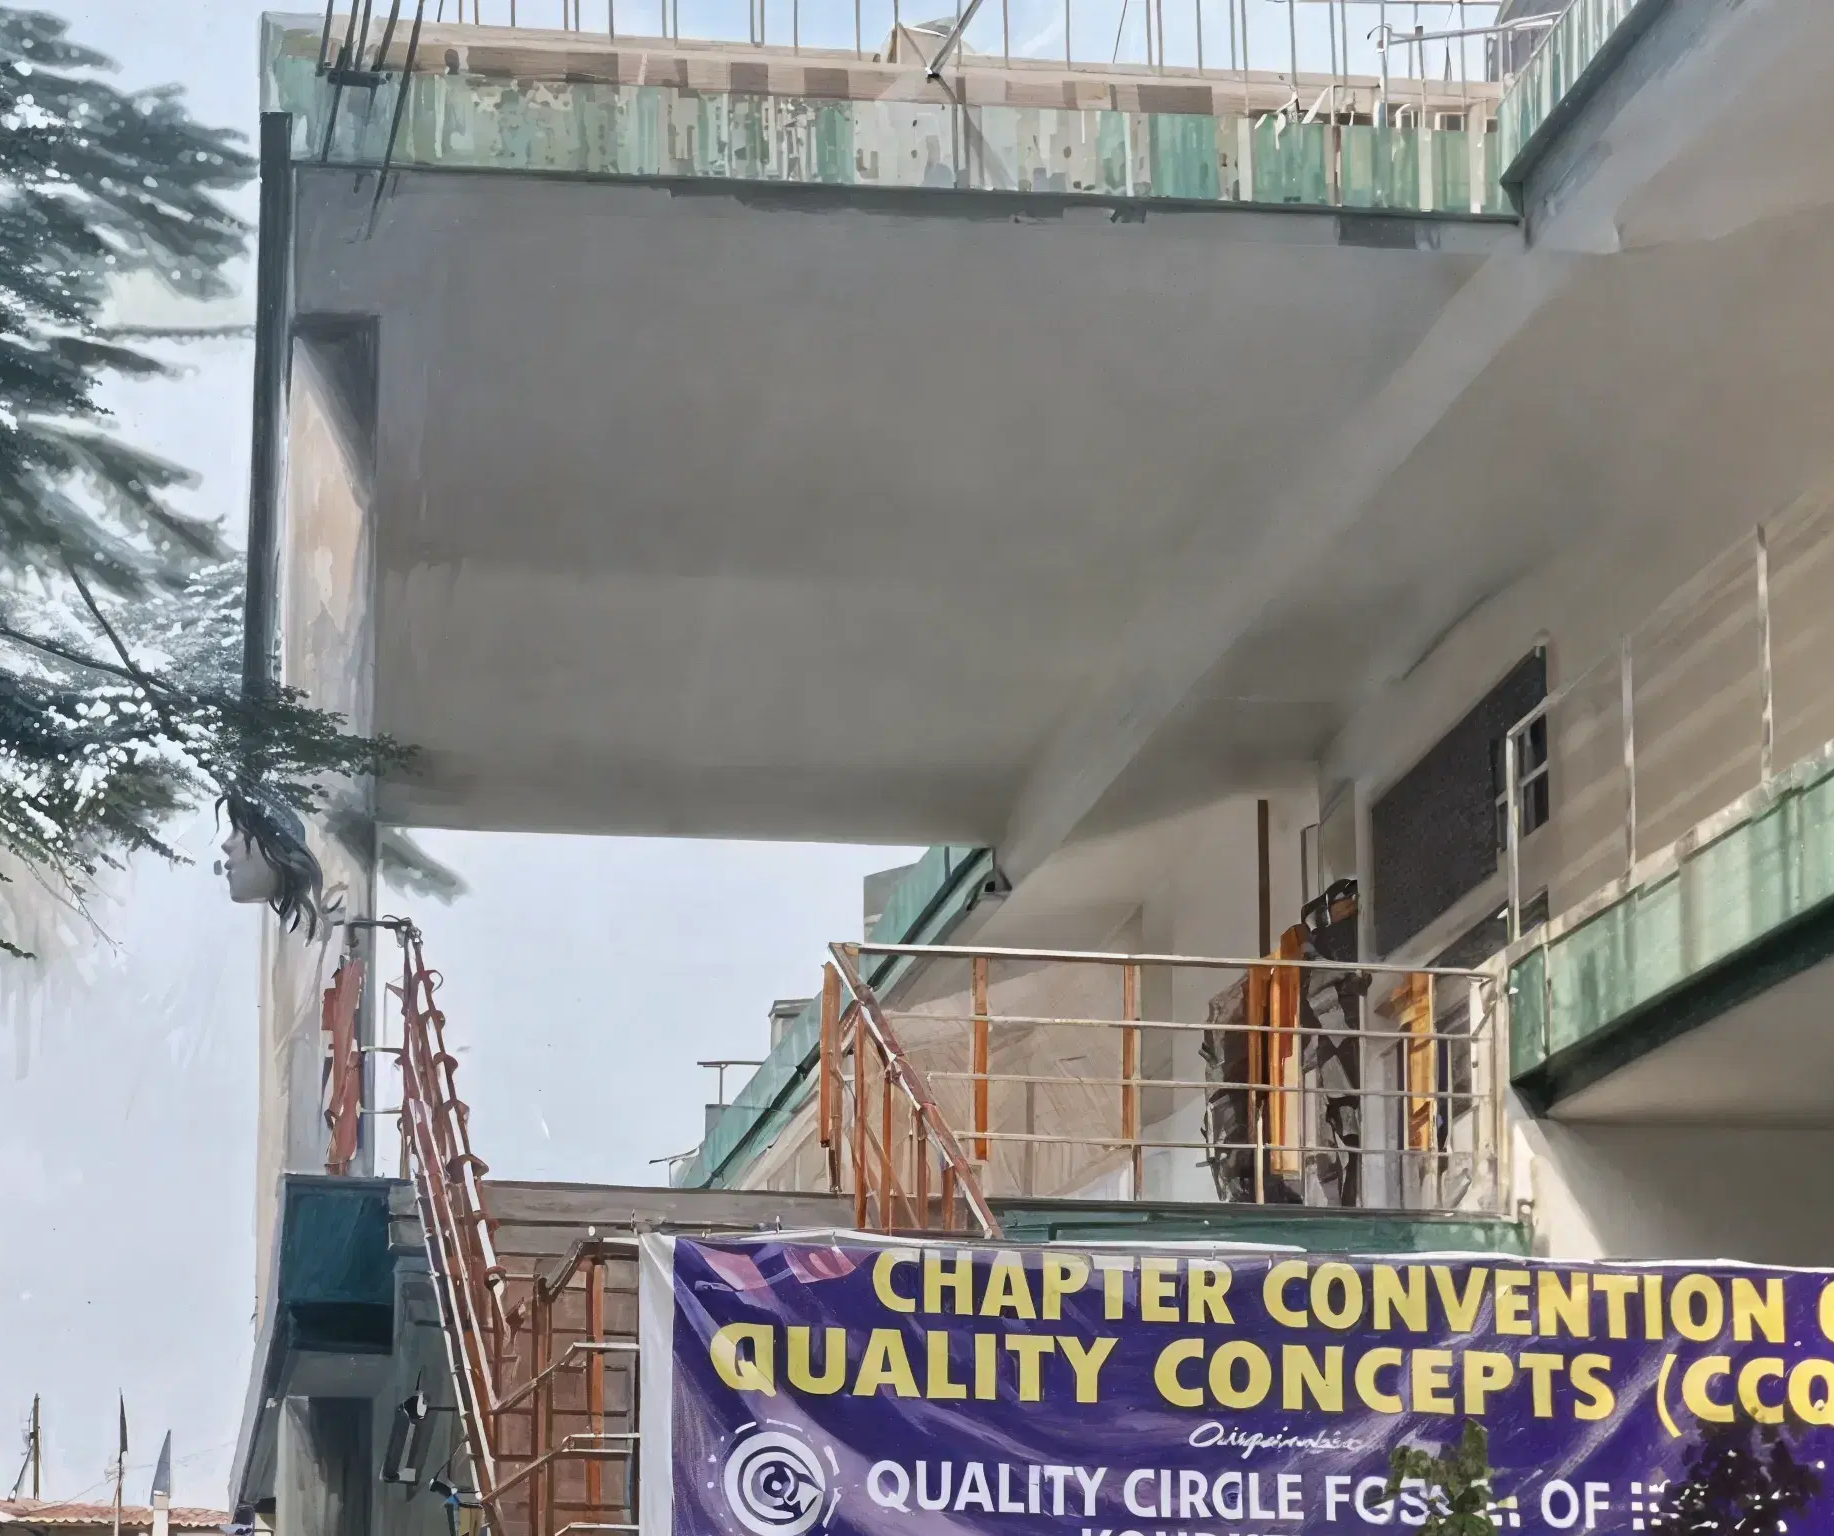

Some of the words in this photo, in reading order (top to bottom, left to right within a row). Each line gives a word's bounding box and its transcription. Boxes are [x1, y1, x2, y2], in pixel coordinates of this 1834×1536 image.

[871, 1246, 1235, 1326] CHAPTER
[1263, 1253, 1786, 1345] CONVENTION
[708, 1321, 1120, 1404] QUALITY
[1153, 1337, 1617, 1421] CONCEPTS
[866, 1458, 1108, 1517] QUALITY
[1540, 1479, 1610, 1530] OF
